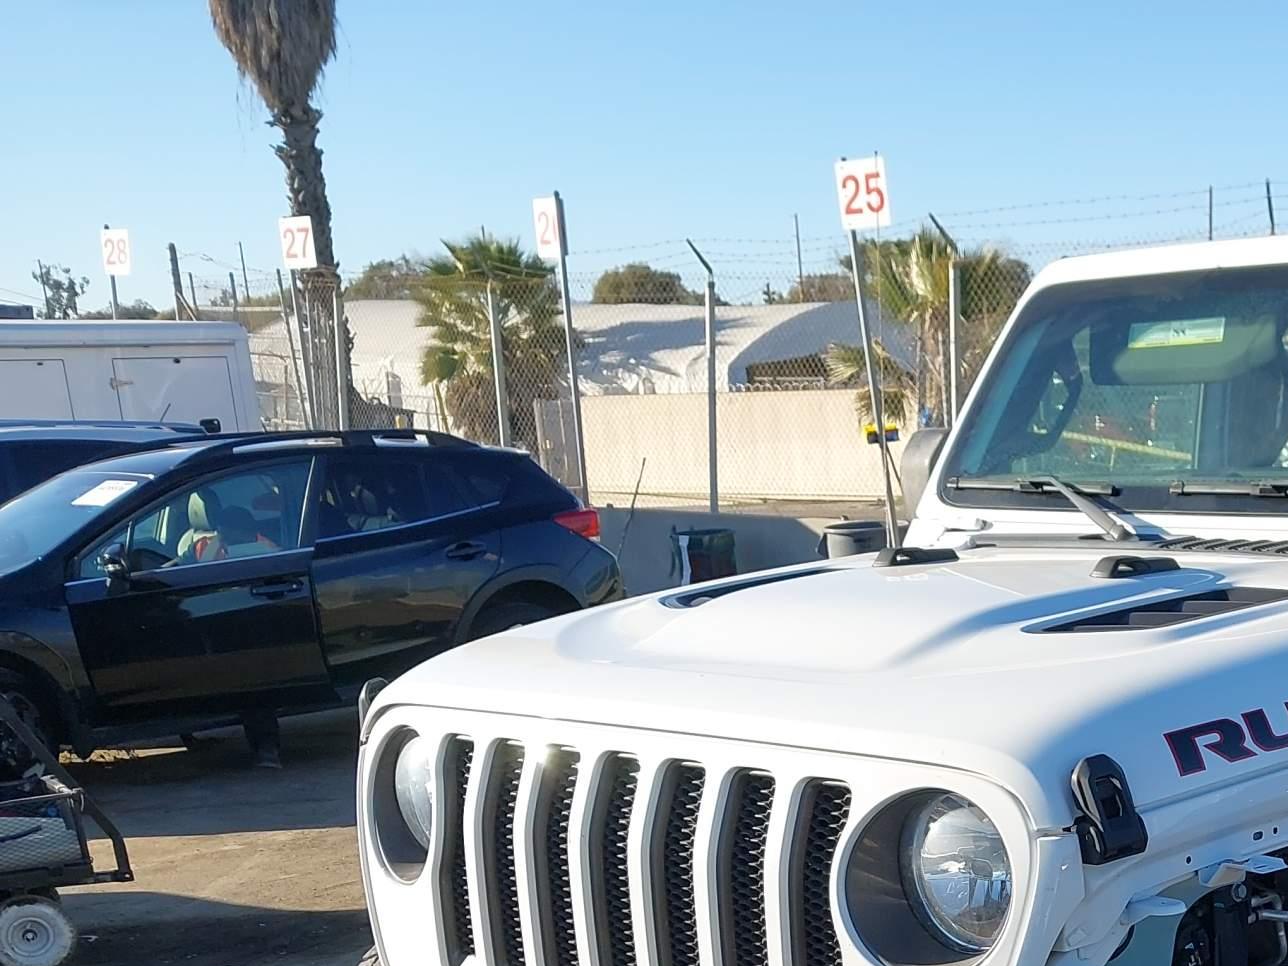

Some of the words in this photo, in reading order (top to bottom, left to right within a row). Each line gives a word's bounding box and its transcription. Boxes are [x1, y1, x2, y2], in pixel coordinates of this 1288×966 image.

[842, 171, 884, 214] 25
[104, 238, 127, 265] 28
[283, 227, 309, 258] 27
